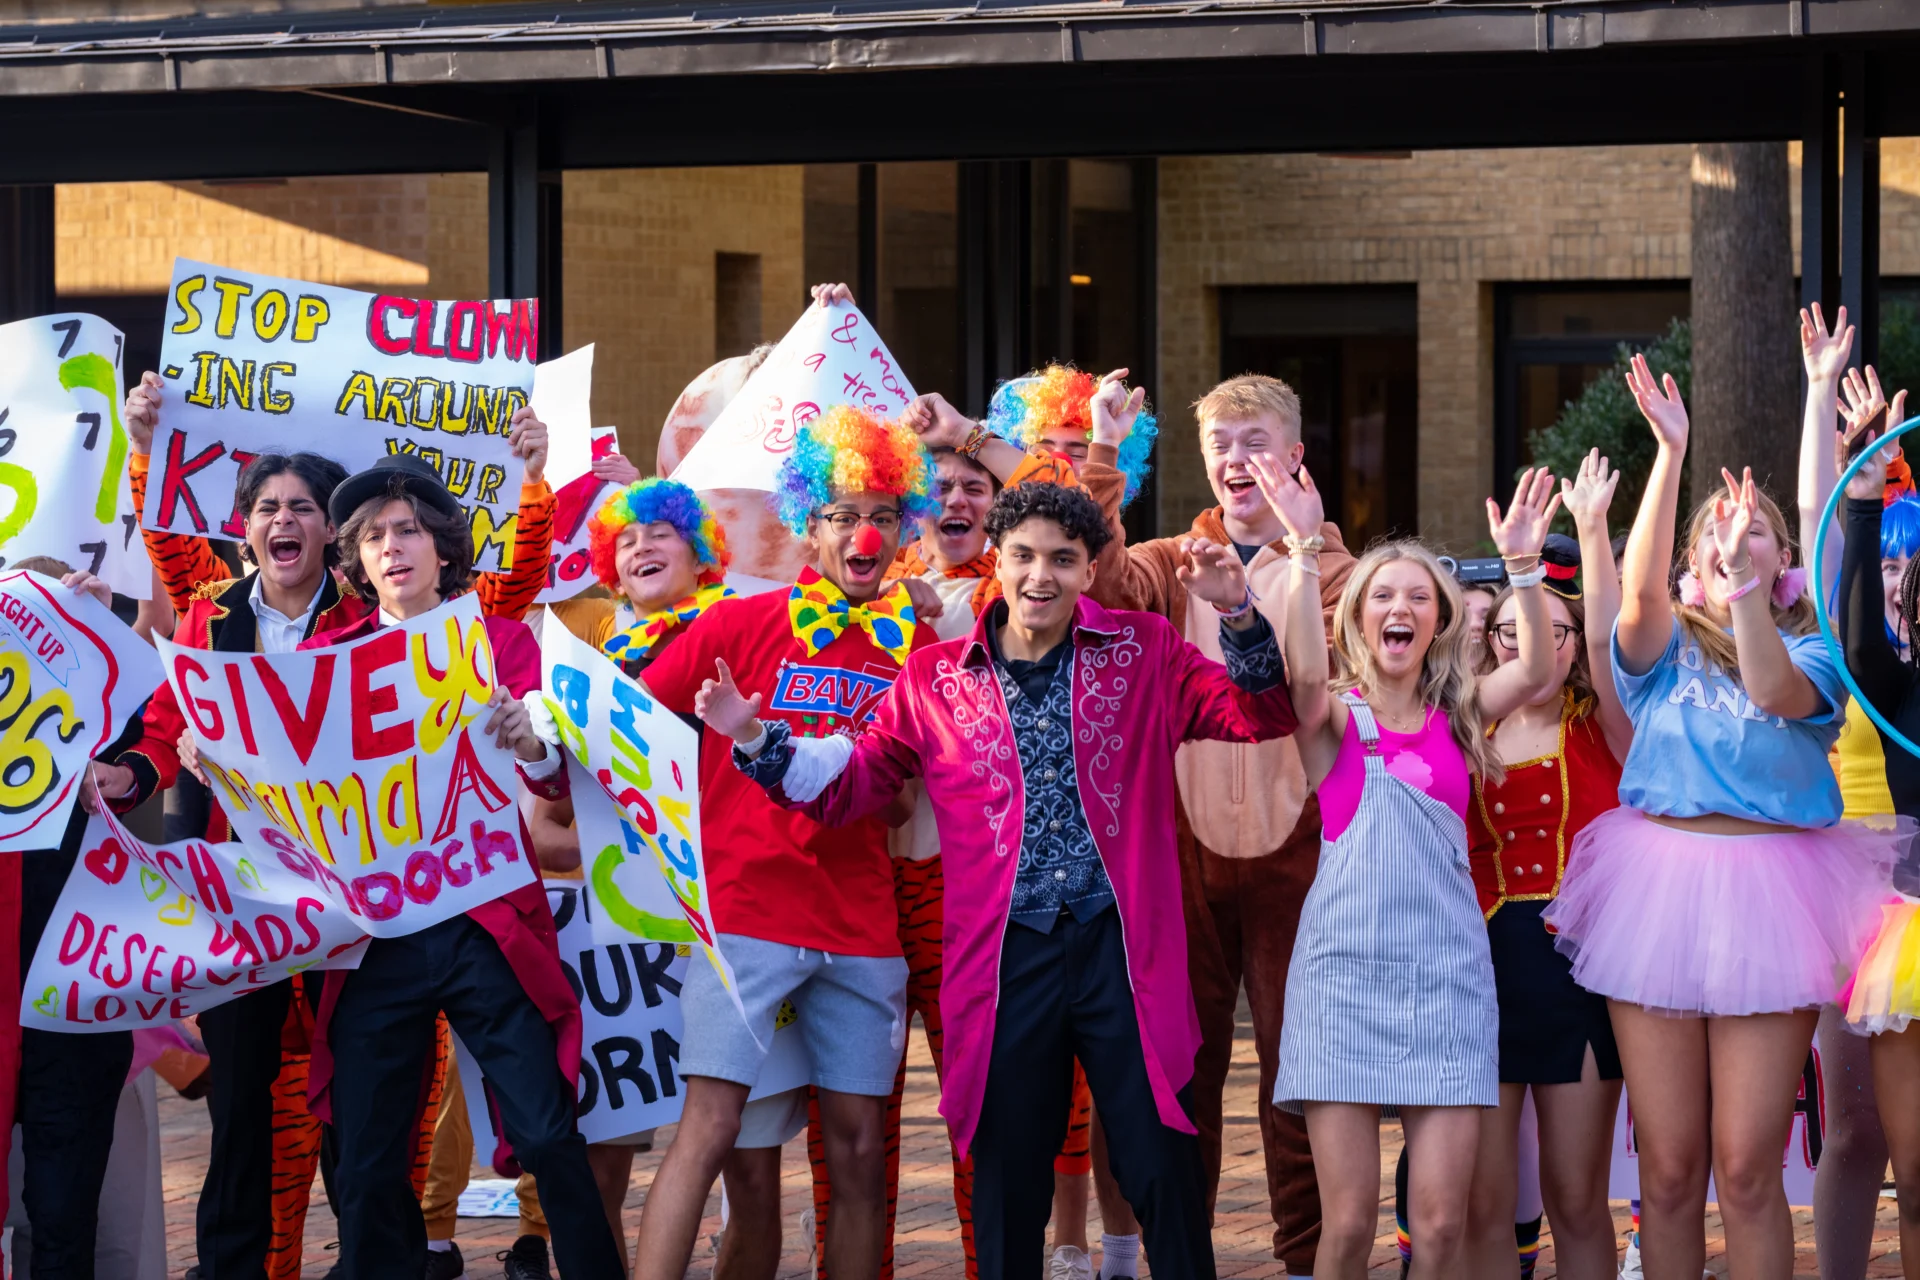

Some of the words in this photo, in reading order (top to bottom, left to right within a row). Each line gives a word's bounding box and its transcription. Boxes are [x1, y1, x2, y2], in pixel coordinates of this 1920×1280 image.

[52, 319, 82, 359] 7
[172, 274, 331, 343] STOP
[366, 294, 539, 365] CLOWN
[335, 370, 529, 439] AROUND
[155, 428, 261, 540] KI
[37, 631, 65, 664] UP
[174, 628, 416, 766] GIVE
[431, 725, 512, 846] A
[58, 910, 272, 996] DESERVE
[65, 981, 192, 1024] LOVE
